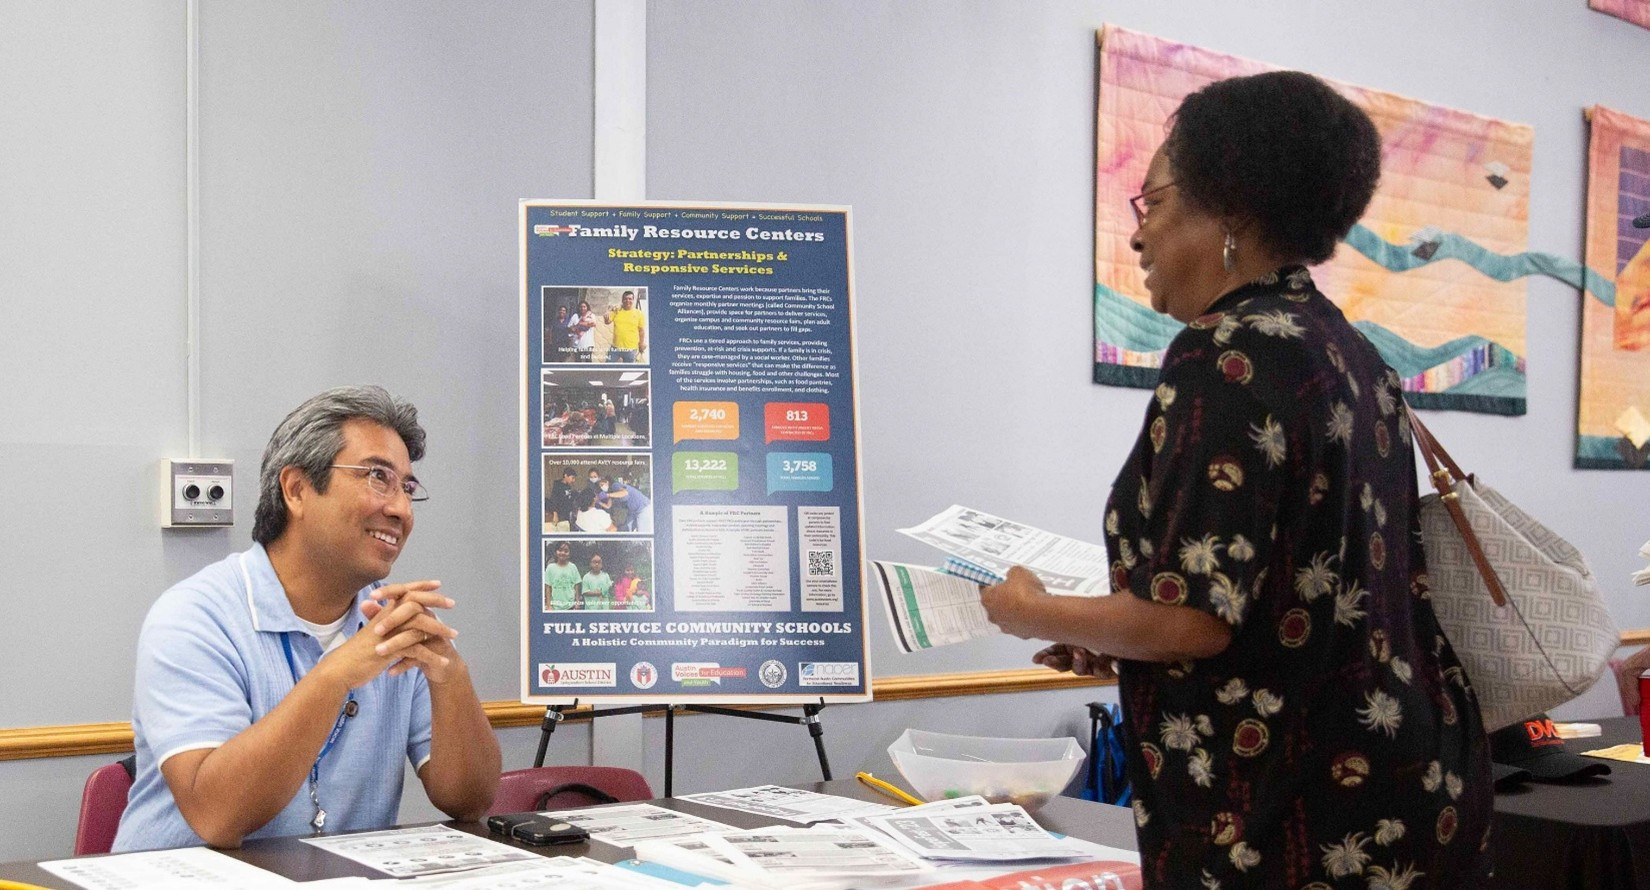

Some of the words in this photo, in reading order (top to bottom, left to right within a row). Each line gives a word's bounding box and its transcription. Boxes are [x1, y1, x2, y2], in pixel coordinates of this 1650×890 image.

[722, 212, 749, 221] Support
[569, 224, 639, 241] Family
[643, 225, 741, 239] Resource
[746, 227, 824, 242] Centers
[608, 248, 674, 261] Strategy:
[677, 250, 774, 263] Partnerships
[776, 252, 788, 261] &
[623, 263, 708, 274] Responsive
[712, 264, 773, 275] Services
[690, 408, 726, 422] 2,740
[786, 410, 808, 421] 813
[684, 459, 727, 472] 13,222
[782, 460, 817, 473] 3,758
[543, 623, 585, 634] FULL
[589, 622, 661, 633] SERVICE
[666, 622, 772, 633] COMMUNITY
[776, 622, 852, 633] SCHOOLS
[582, 638, 627, 646] Holistic
[630, 638, 698, 648] Community
[700, 638, 759, 647] Paradigm
[761, 638, 778, 646] for
[780, 638, 824, 646] Success
[561, 669, 611, 680] AUSTIN
